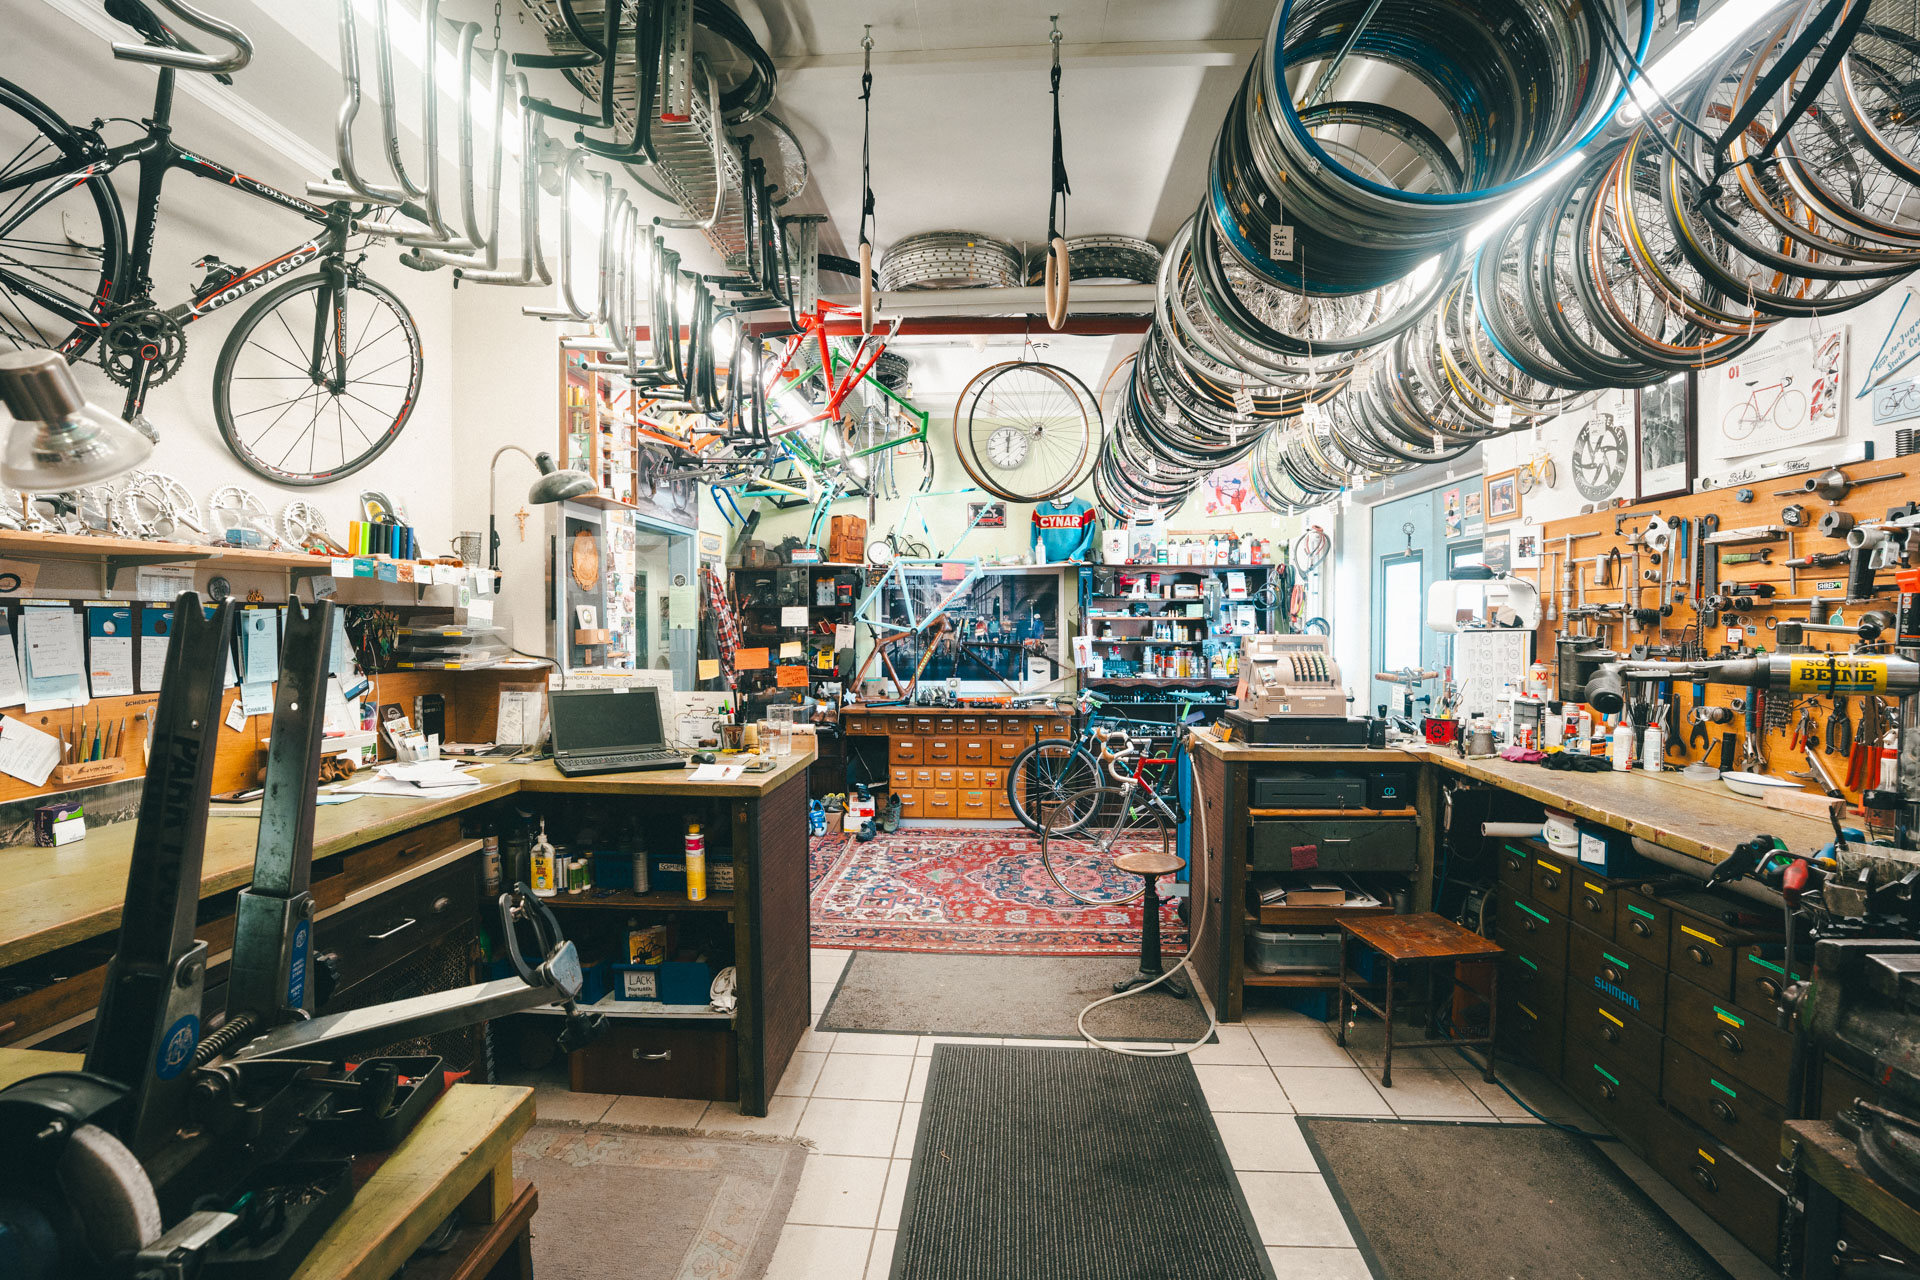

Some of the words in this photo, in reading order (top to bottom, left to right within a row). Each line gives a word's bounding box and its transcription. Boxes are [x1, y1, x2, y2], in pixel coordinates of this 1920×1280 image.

[256, 184, 314, 212] COLNAGO
[204, 262, 237, 276] COLNAGO
[209, 254, 306, 310] COLNAGO
[1728, 365, 1740, 380] 01
[1728, 469, 1757, 483] Bike
[1040, 516, 1081, 527] CYNAR
[1799, 667, 1877, 683] BEINE
